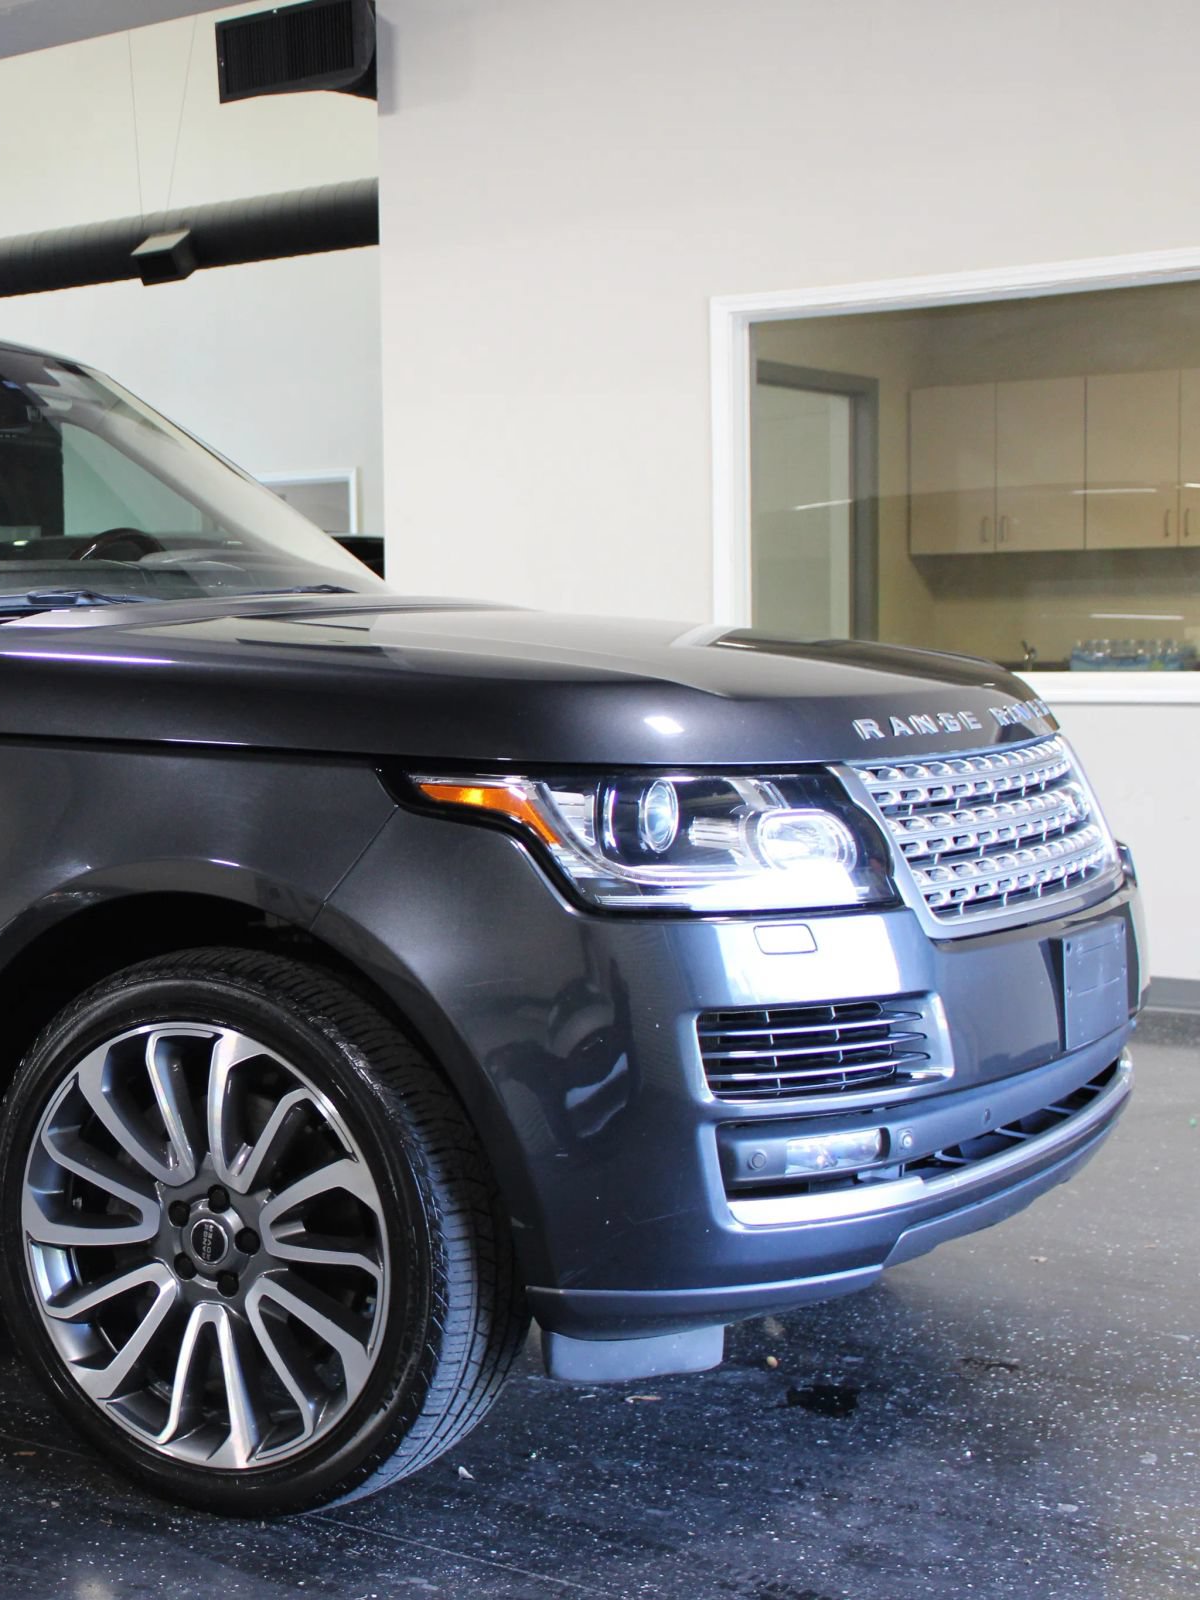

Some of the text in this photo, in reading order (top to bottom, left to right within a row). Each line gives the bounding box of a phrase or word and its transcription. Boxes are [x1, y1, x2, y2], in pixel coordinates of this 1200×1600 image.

[853, 710, 982, 740] RANGE
[201, 1223, 209, 1260] RANGE
[206, 1224, 214, 1261] ROVER
